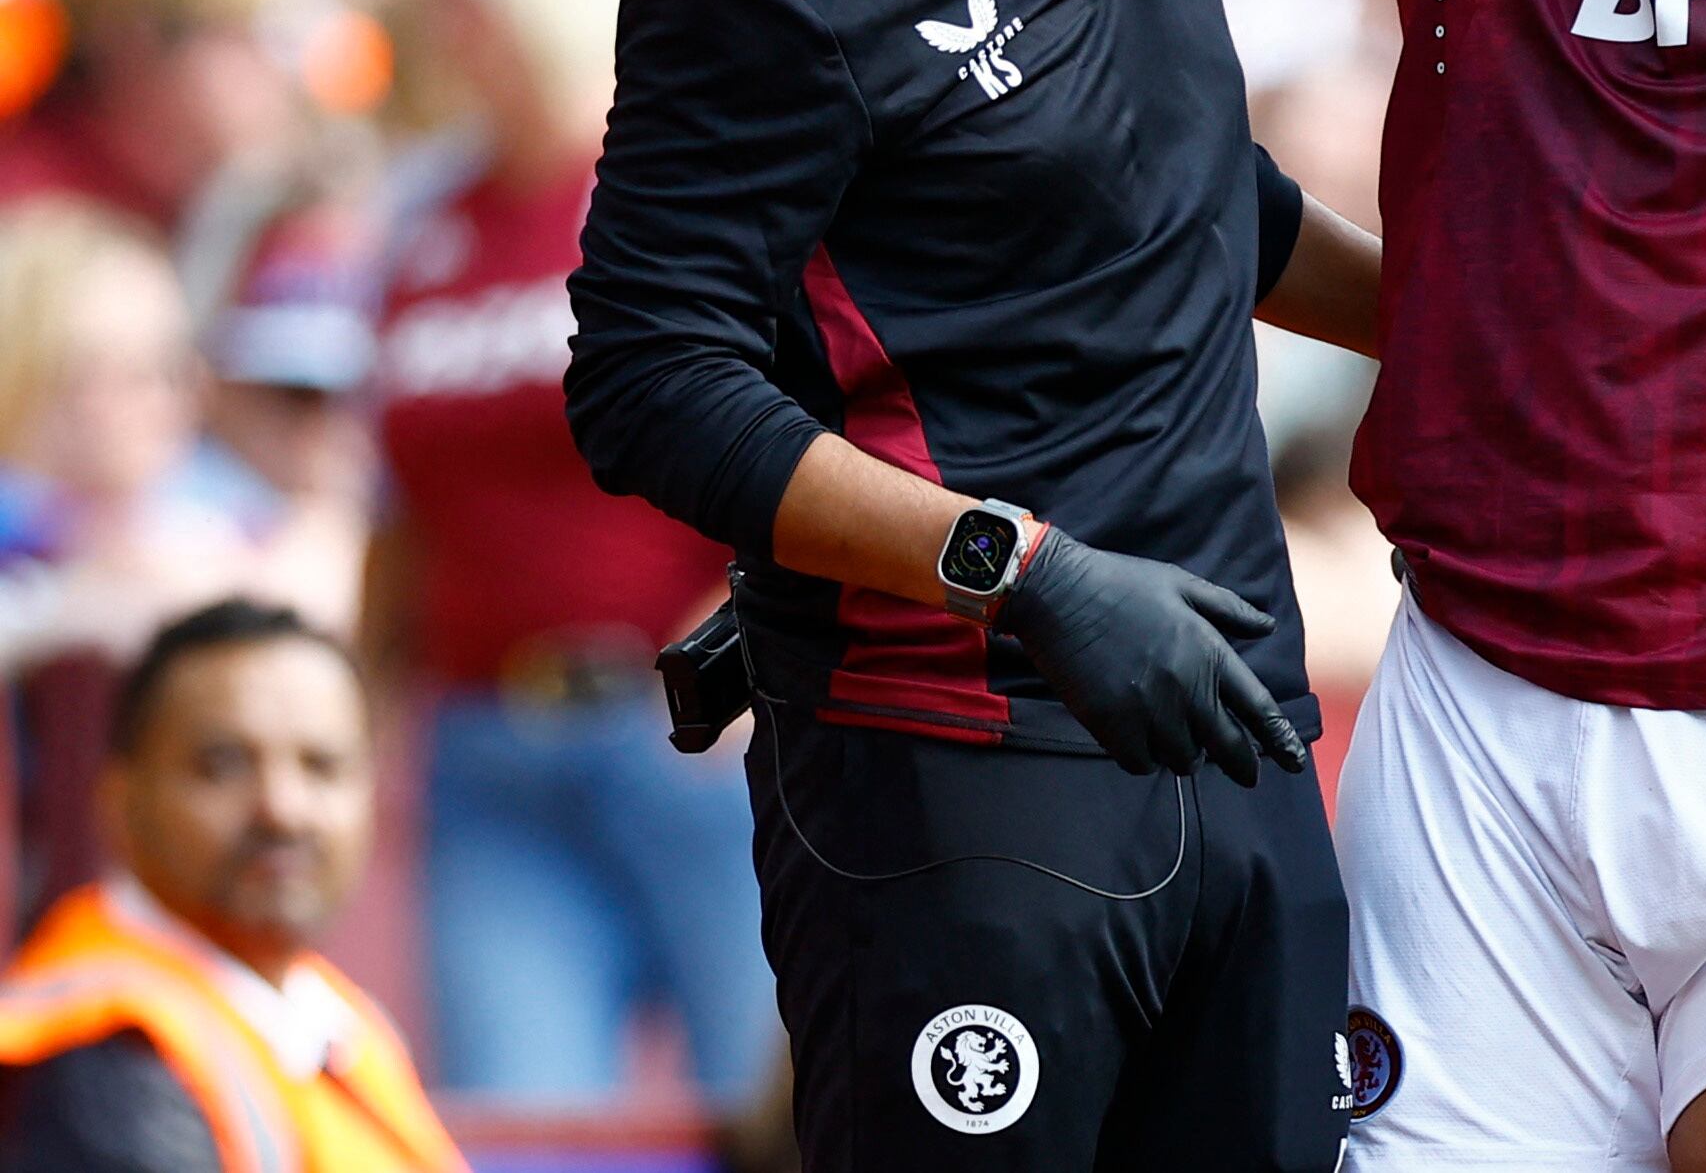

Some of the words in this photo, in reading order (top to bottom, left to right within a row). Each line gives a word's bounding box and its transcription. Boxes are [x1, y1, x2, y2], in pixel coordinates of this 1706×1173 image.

[974, 48, 1023, 100] KS
[926, 1009, 976, 1043] ASTON
[984, 1010, 1025, 1045] VILLA
[966, 1119, 989, 1128] 1874
